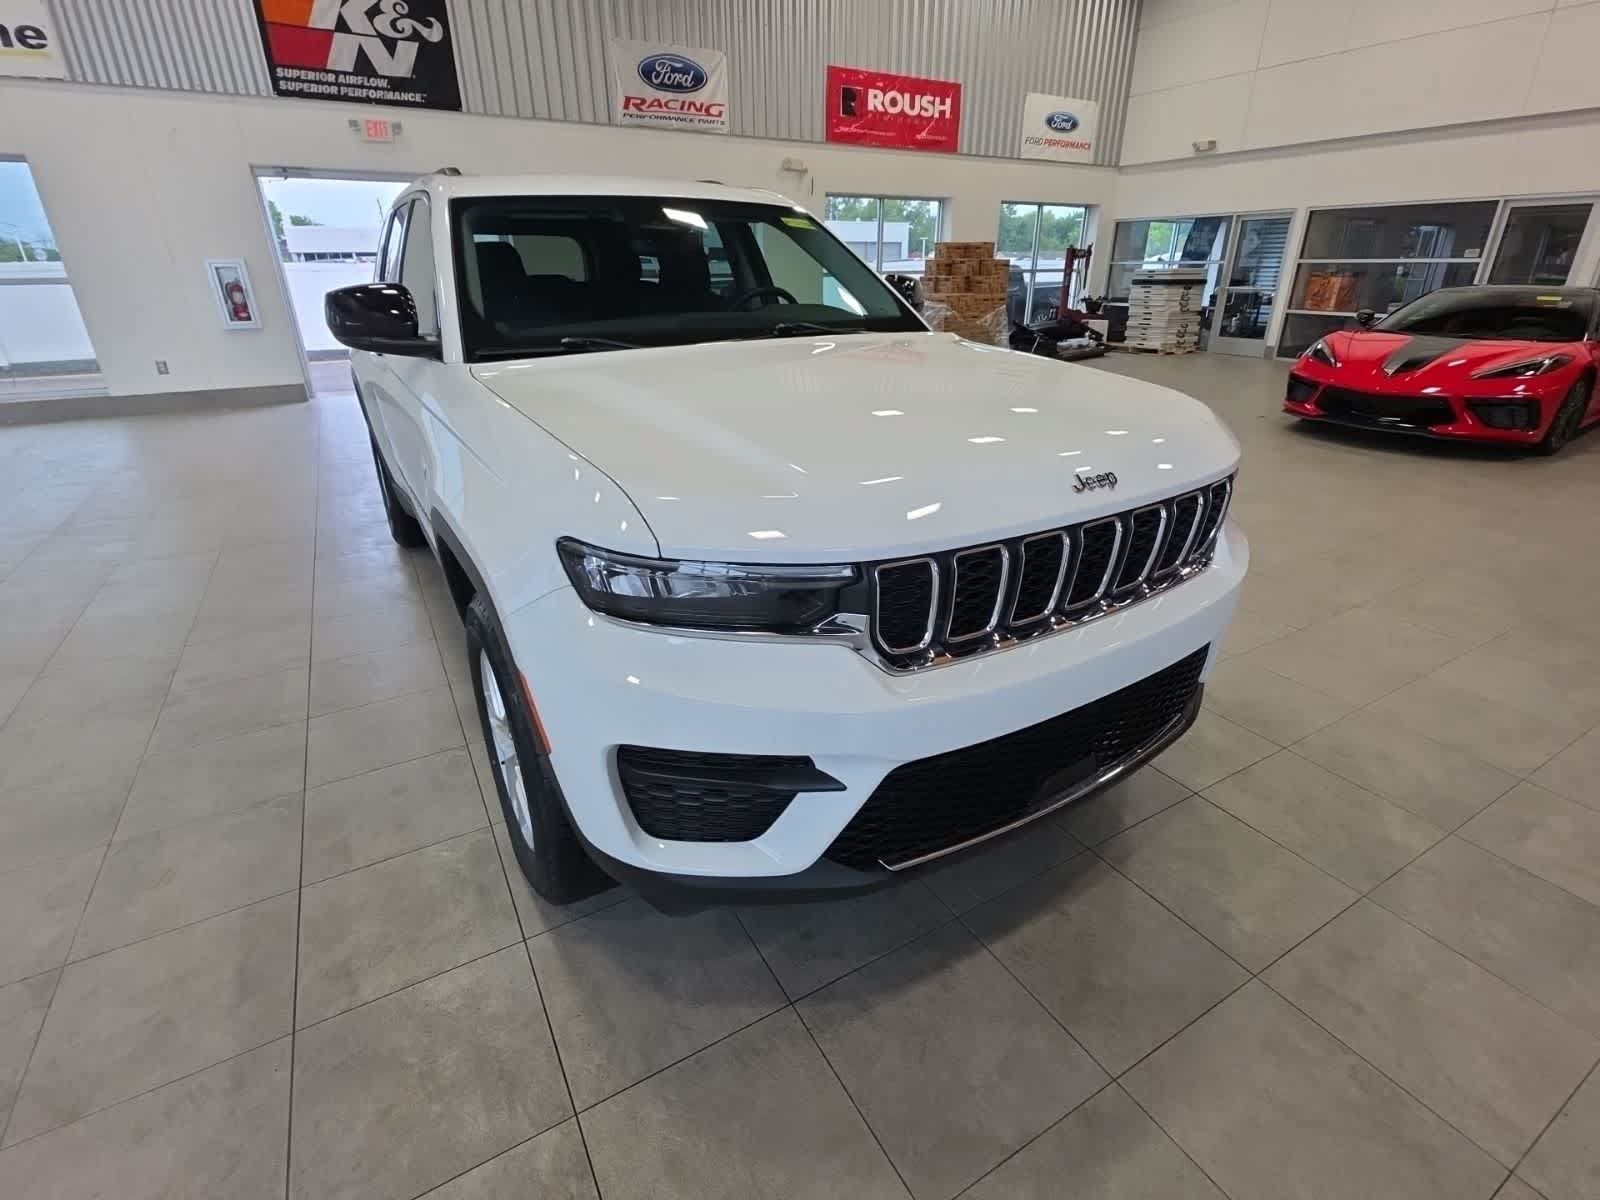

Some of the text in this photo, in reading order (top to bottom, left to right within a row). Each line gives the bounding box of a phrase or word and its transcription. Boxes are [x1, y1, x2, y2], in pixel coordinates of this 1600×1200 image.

[275, 67, 391, 89] SUPERIOR AIRFLOW.
[651, 59, 695, 88] Ford
[279, 80, 425, 102] SUPERIOR PERFORMANCE.
[622, 95, 725, 118] RACING
[867, 88, 952, 119] ROUSH
[365, 119, 389, 138] EXIT
[623, 112, 696, 123] PERFORMANCE
[1051, 114, 1074, 130] Ford
[1024, 136, 1044, 146] FORD
[1072, 471, 1118, 494] Jeep
